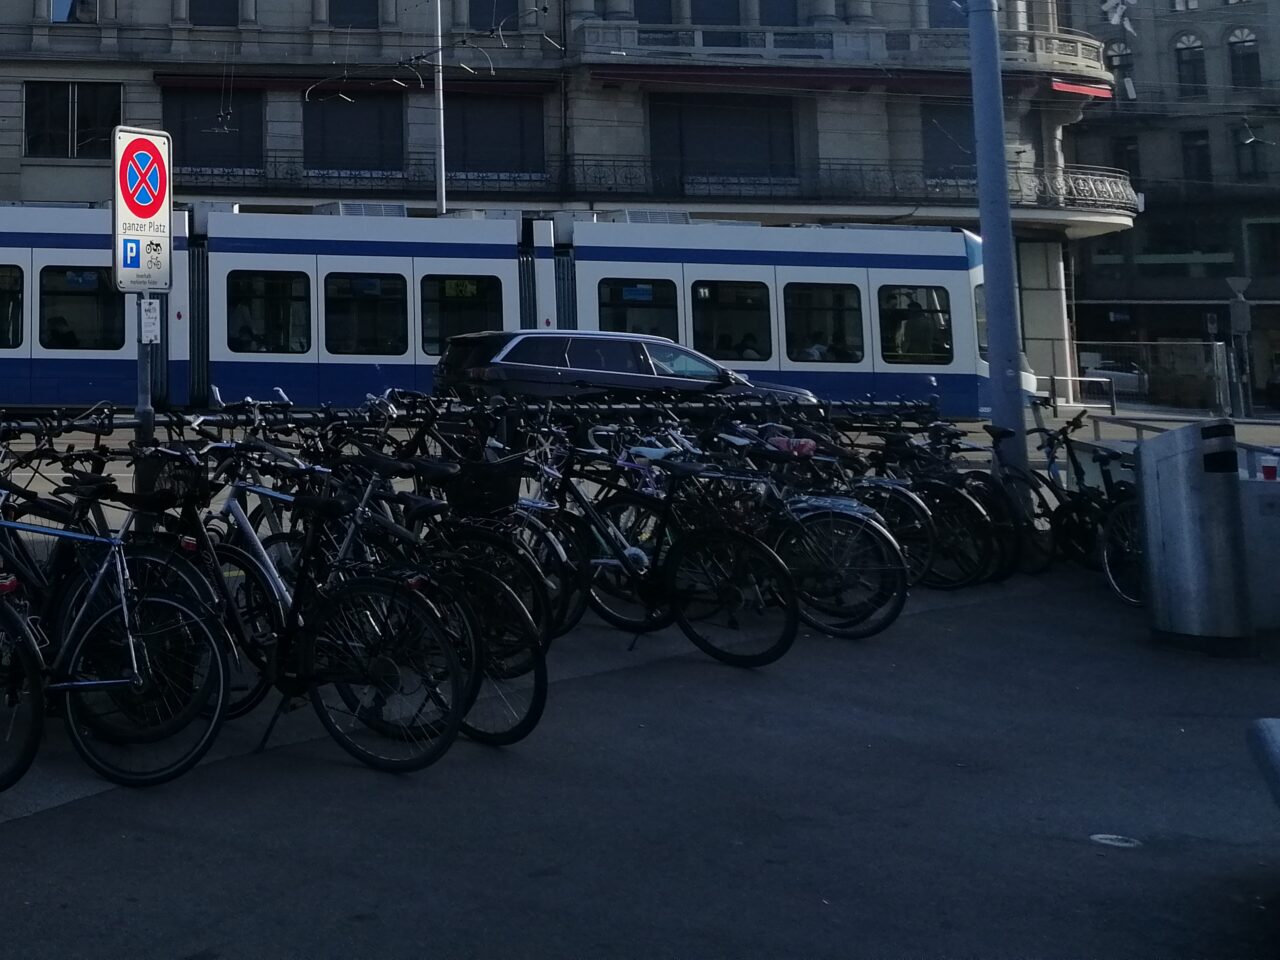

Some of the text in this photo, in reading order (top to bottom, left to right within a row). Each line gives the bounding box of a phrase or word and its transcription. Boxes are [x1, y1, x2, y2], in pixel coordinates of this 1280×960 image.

[122, 221, 166, 233] ganzer Platz
[127, 242, 136, 264] P
[699, 287, 709, 298] 11
